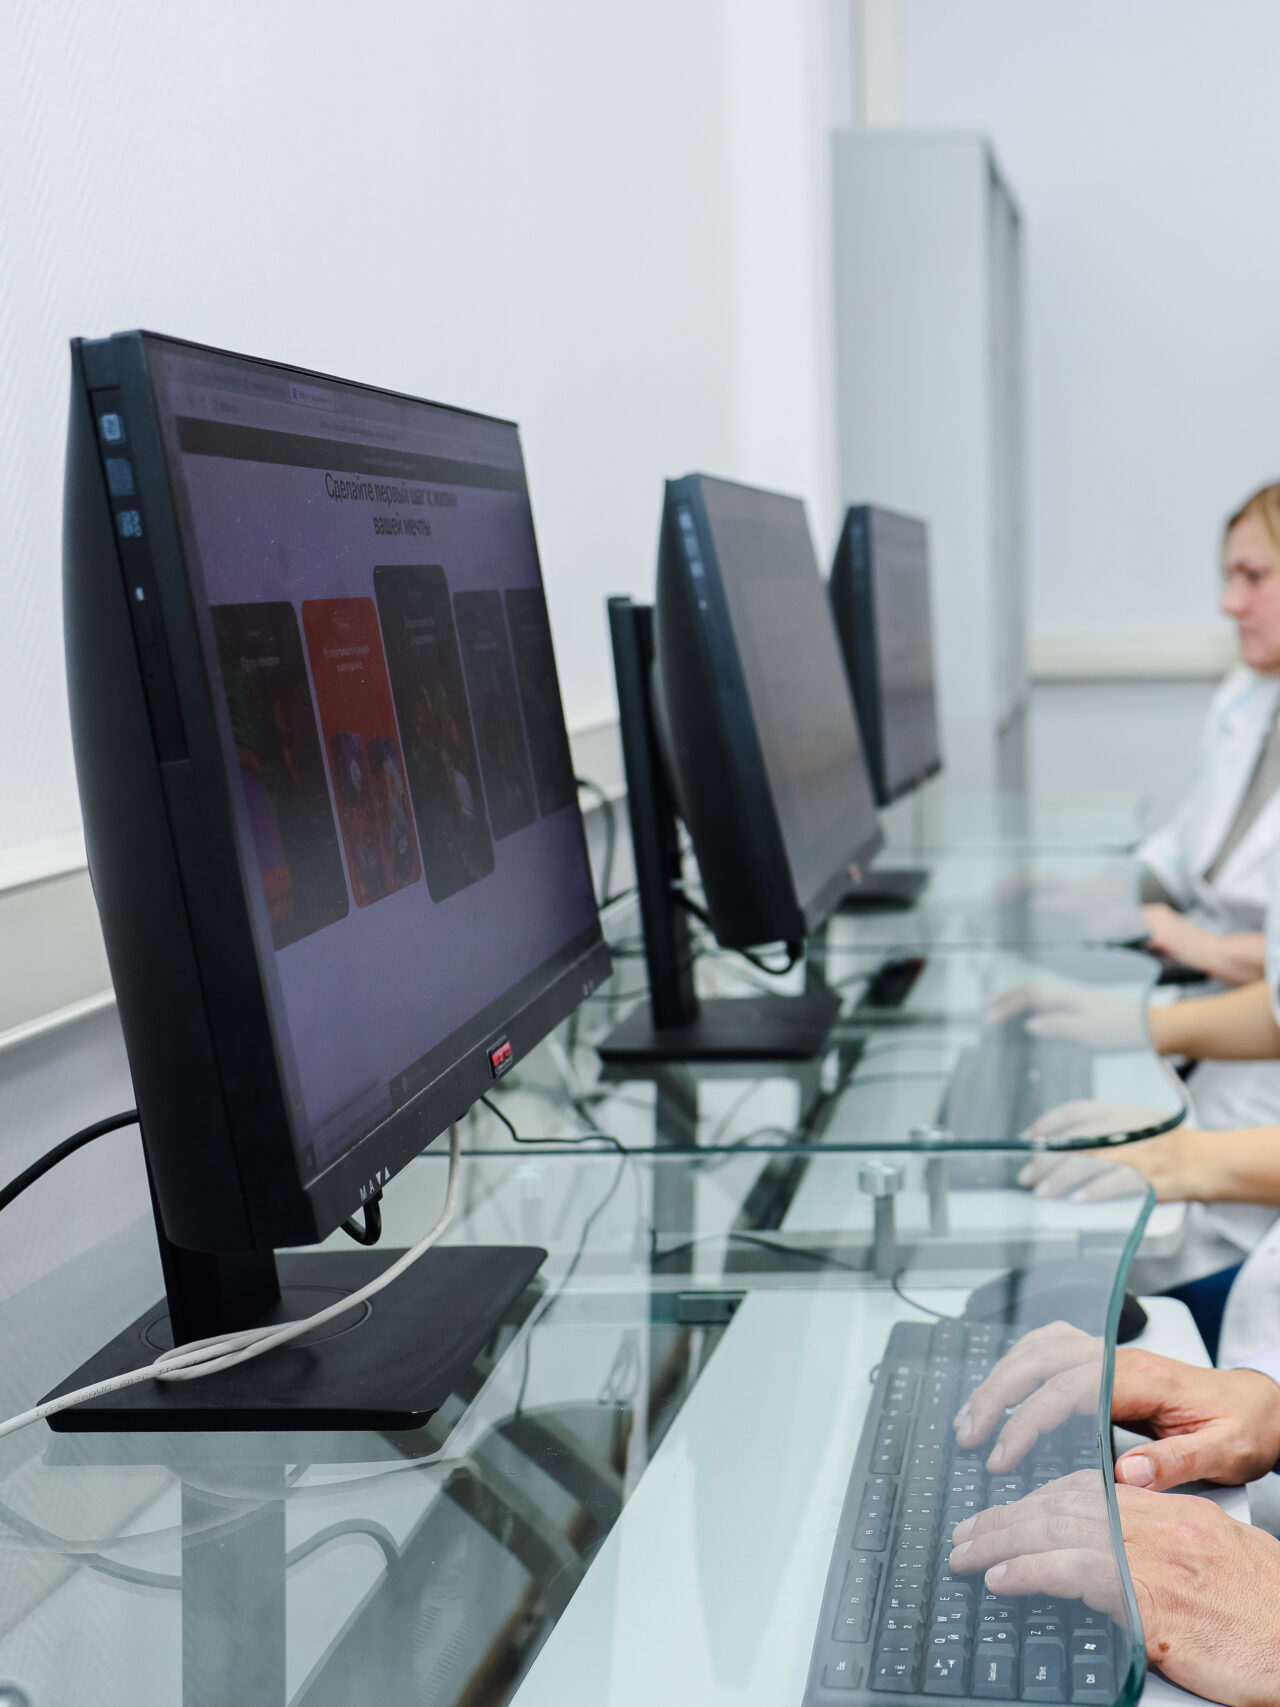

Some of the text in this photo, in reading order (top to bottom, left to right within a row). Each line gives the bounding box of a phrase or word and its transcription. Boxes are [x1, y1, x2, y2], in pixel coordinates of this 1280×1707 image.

[324, 471, 374, 503] Сделайте
[374, 481, 409, 507] первый
[372, 512, 432, 537] вашей мечты
